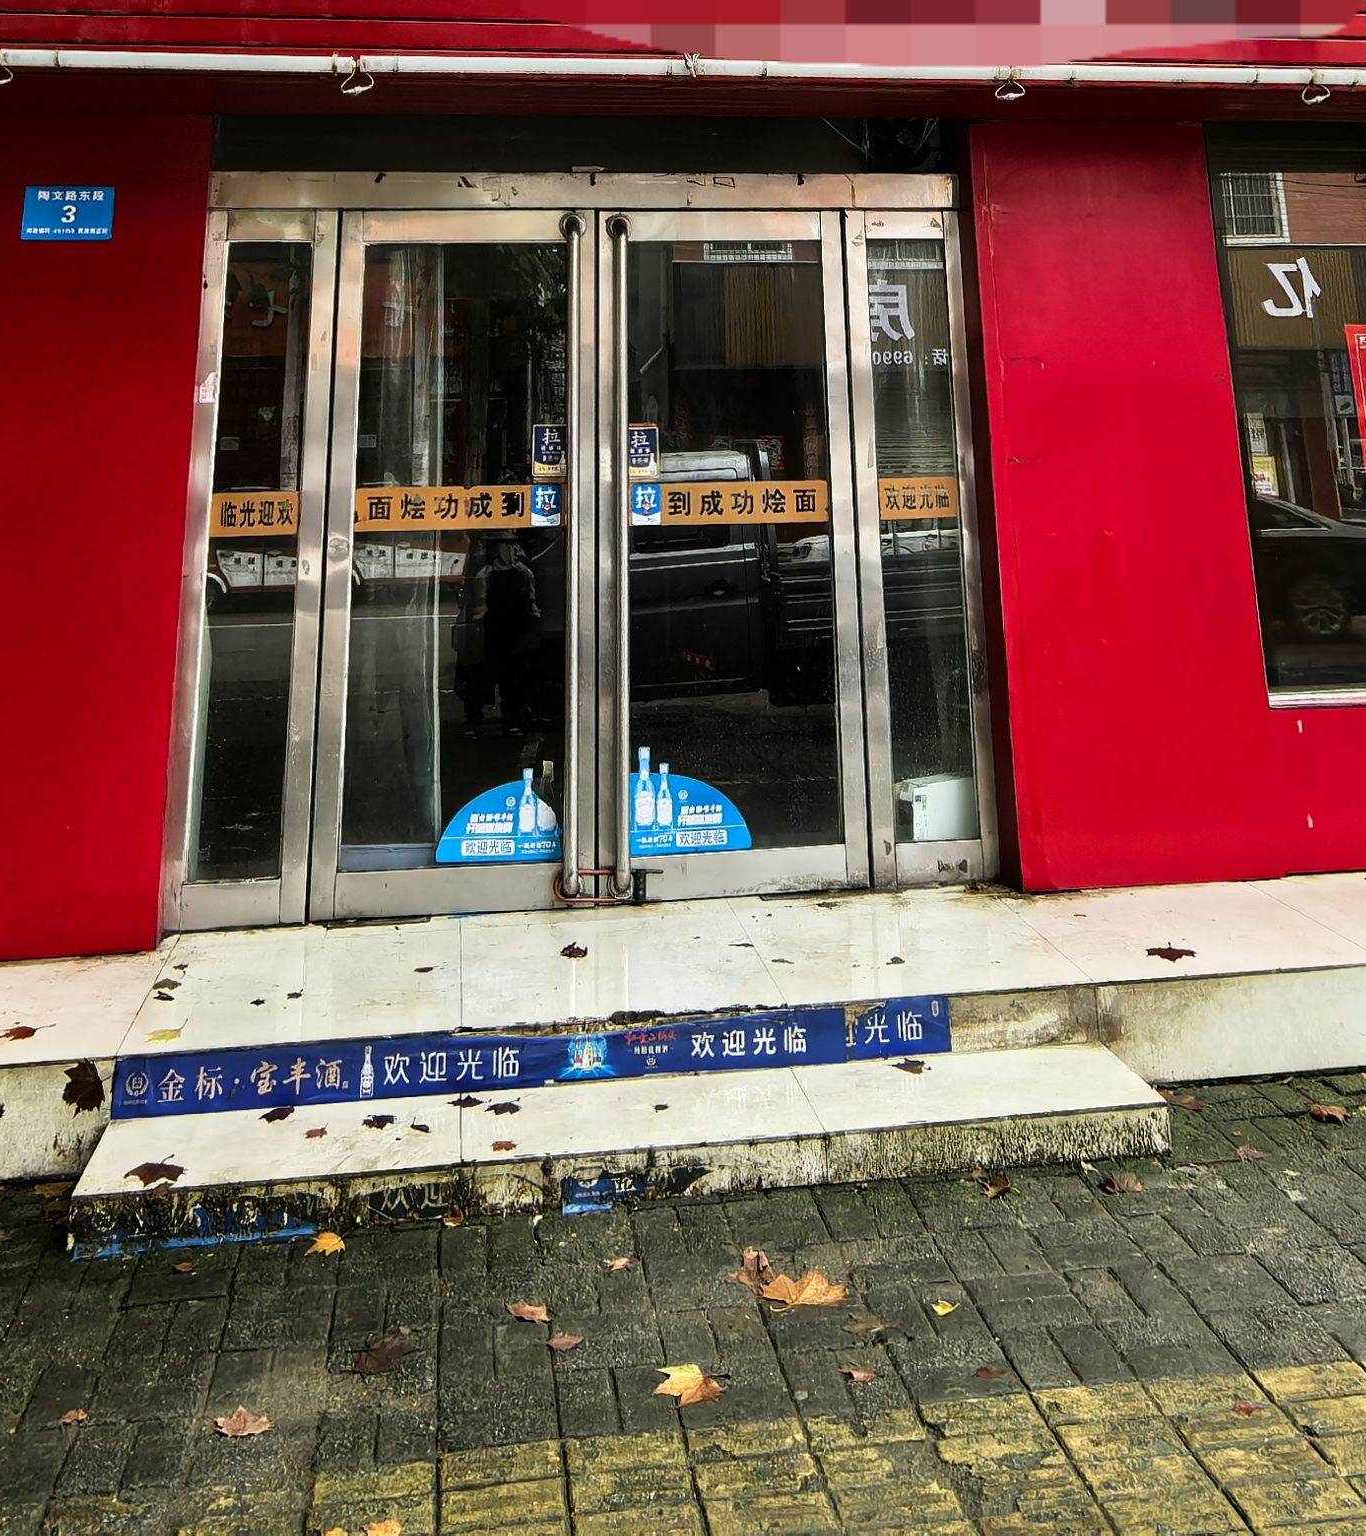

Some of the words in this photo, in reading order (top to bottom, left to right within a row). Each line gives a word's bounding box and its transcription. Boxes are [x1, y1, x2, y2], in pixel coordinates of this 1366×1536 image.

[60, 204, 77, 224] 3
[542, 428, 561, 446] 拉
[630, 430, 651, 448] 拉
[535, 486, 557, 510] 拉
[635, 486, 657, 510] 拉
[667, 487, 818, 517] 到成功烩面
[884, 484, 951, 512] 欢迎光临
[465, 839, 513, 855] 欢迎光临
[382, 1046, 521, 1087] 欢迎光临
[690, 1026, 808, 1059] 欢迎光临
[847, 1010, 924, 1046] 光临
